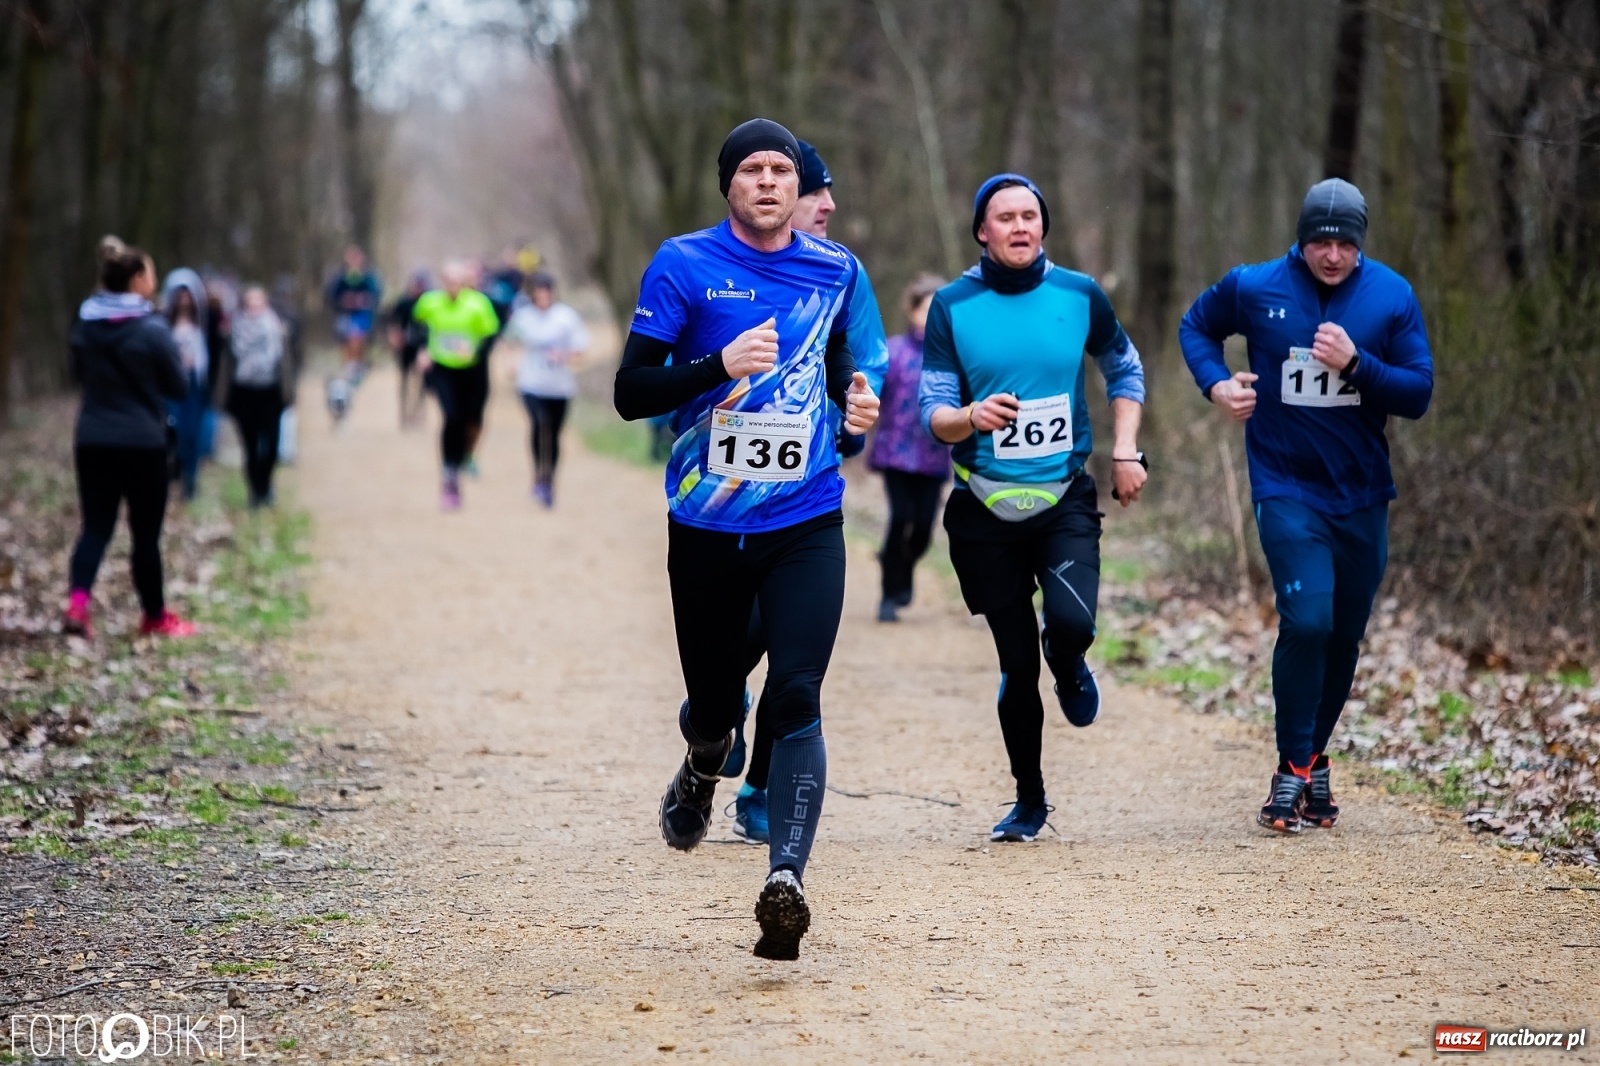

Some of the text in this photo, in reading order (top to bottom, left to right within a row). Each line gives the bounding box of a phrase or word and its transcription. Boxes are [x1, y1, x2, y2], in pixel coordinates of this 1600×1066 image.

[748, 420, 808, 430] www.personalbest.pl
[999, 417, 1067, 448] 262
[717, 435, 803, 470] 136
